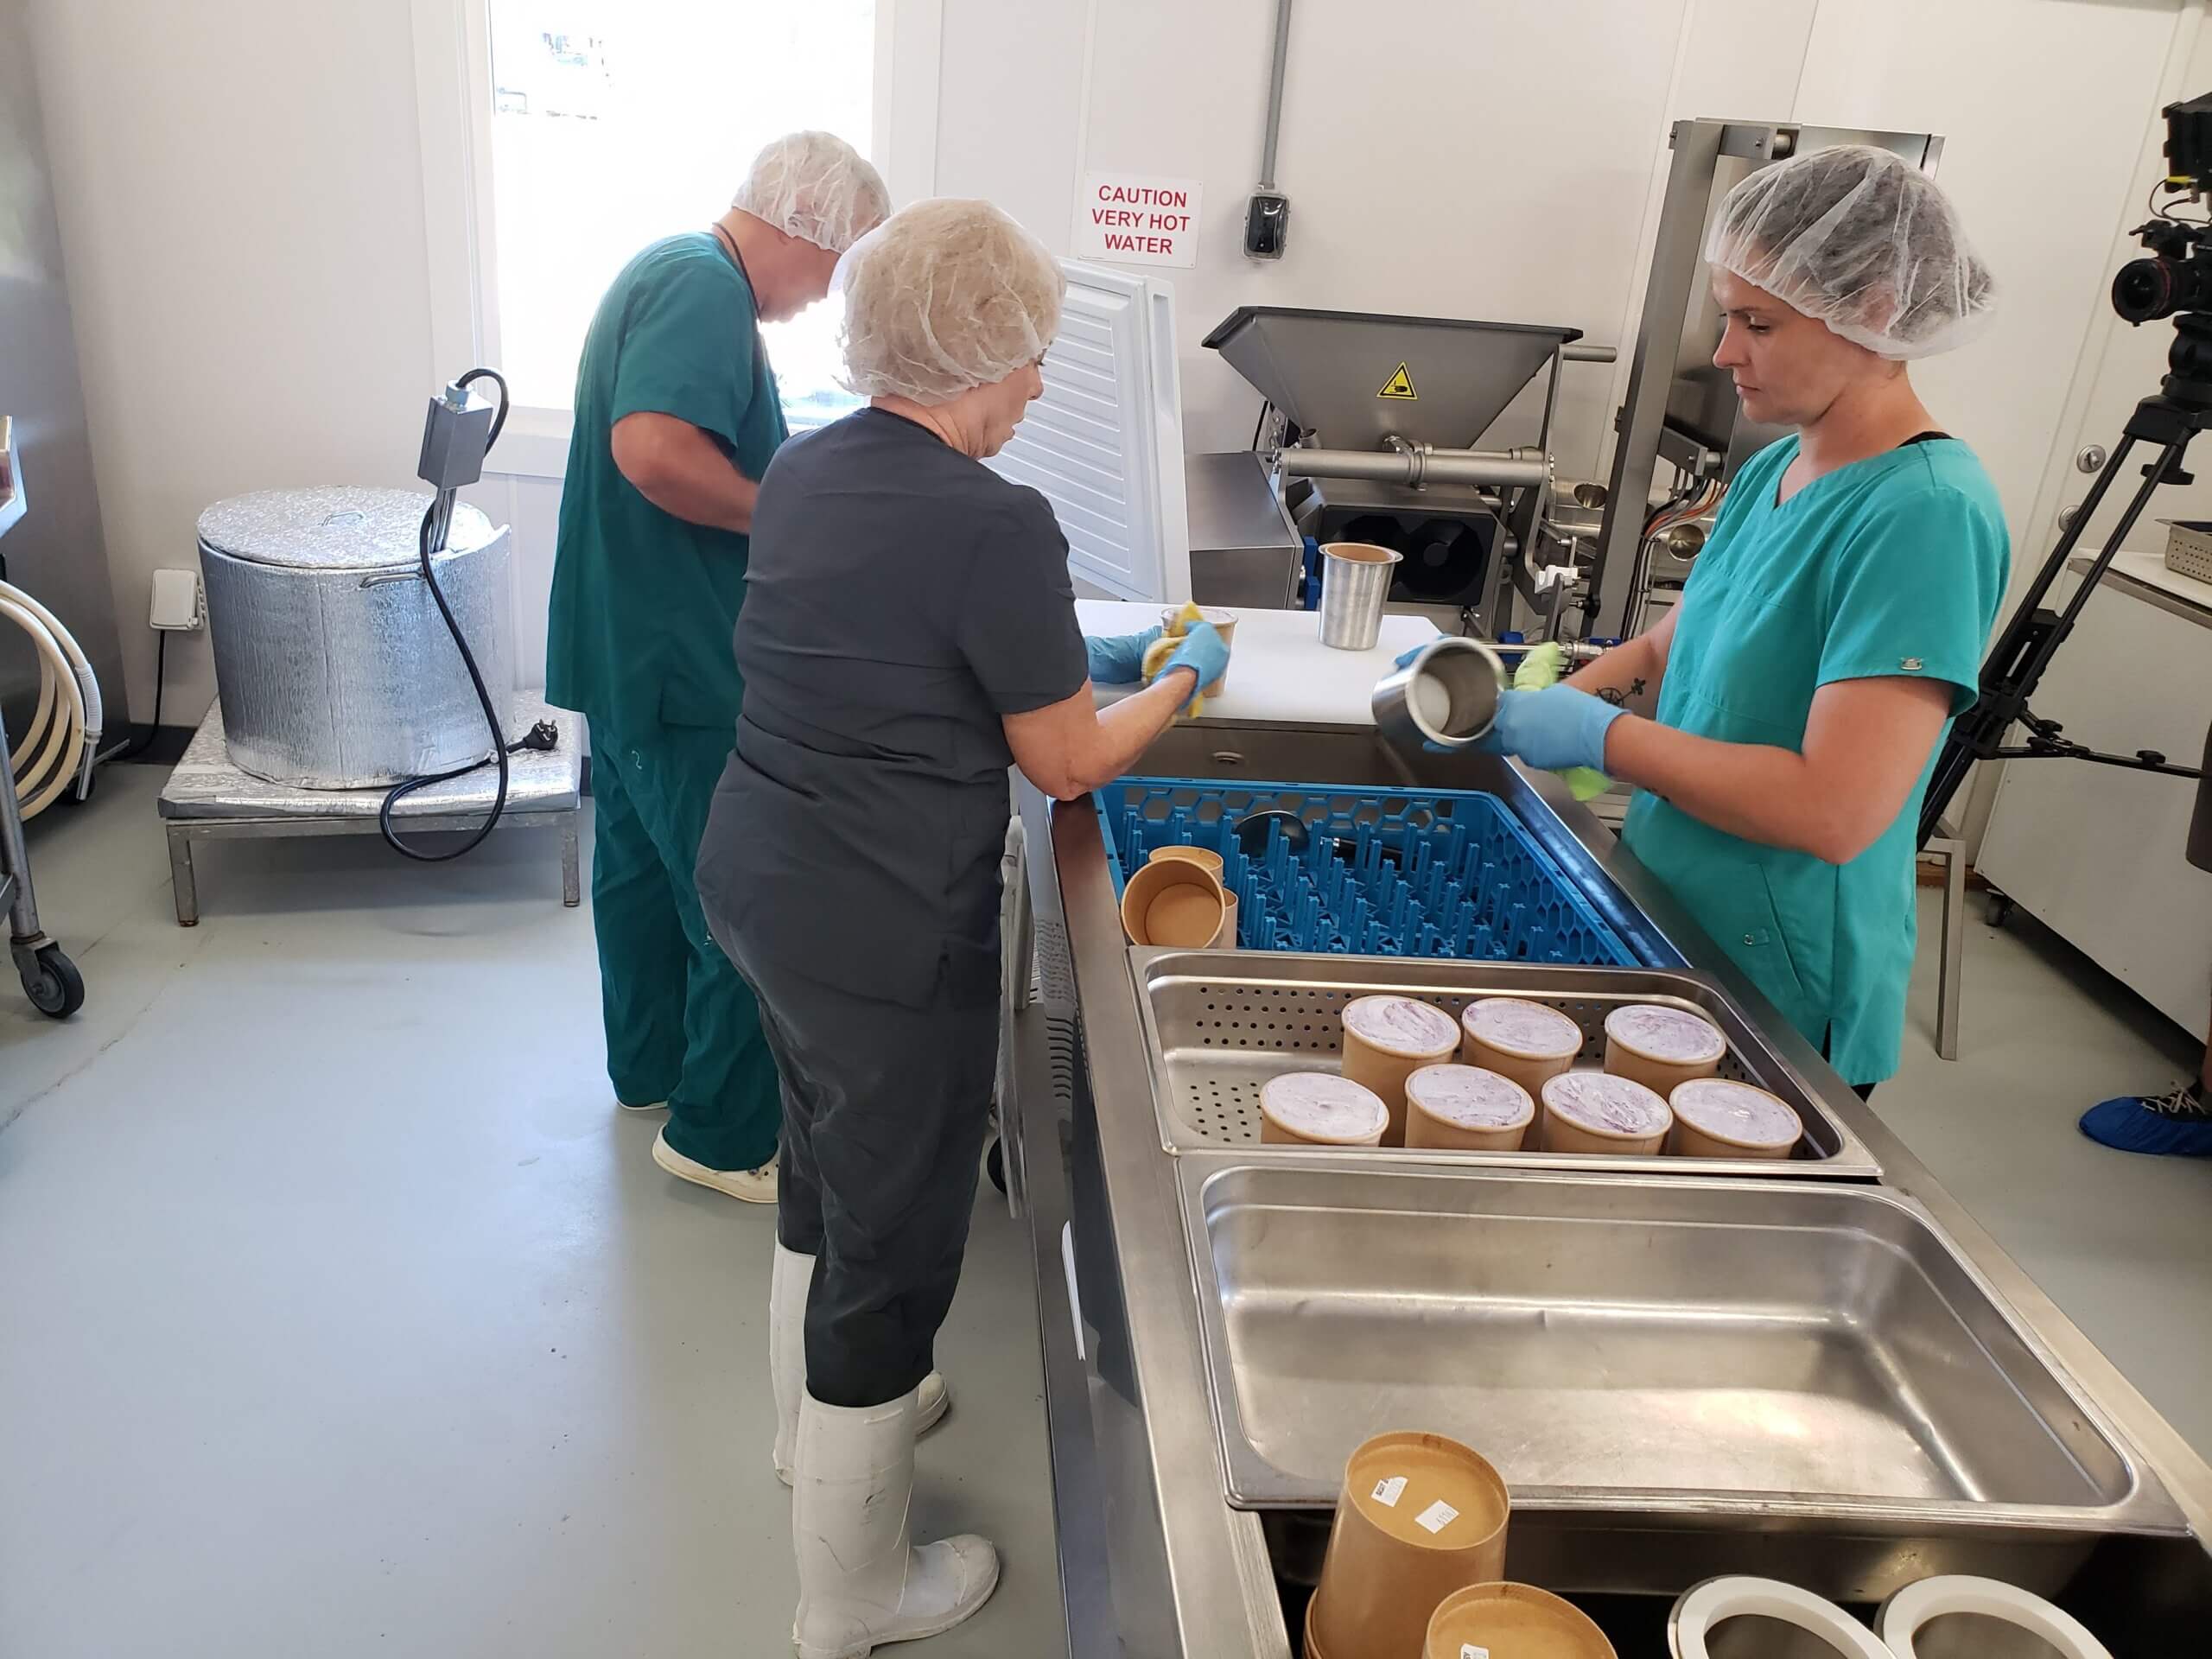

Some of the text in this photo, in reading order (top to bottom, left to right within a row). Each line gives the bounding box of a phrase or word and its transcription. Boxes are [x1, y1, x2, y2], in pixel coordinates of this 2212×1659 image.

[1098, 185, 1187, 208] CAUTION
[1091, 208, 1191, 232] VERY HOT
[1104, 233, 1173, 255] WATER
